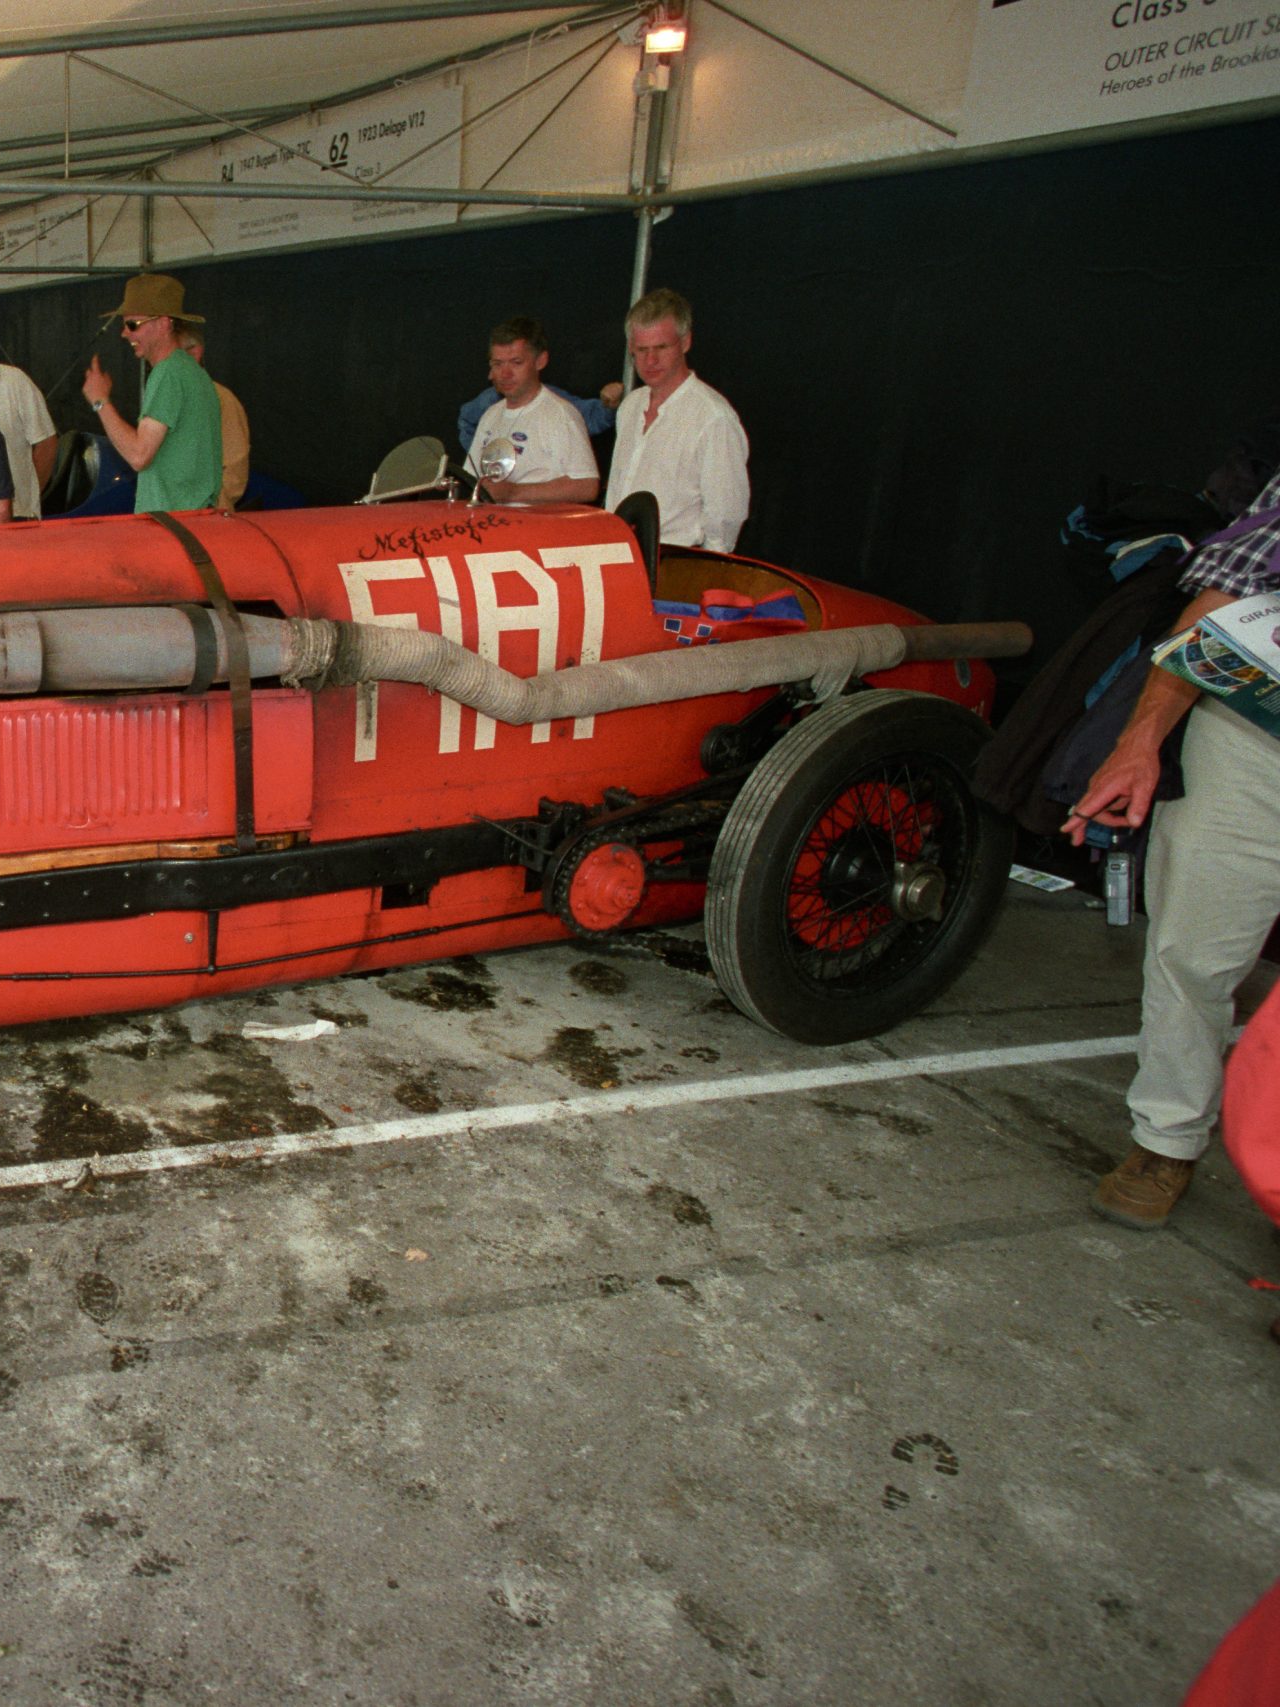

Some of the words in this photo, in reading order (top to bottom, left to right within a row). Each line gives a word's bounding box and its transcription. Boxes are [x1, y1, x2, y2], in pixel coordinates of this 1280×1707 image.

[1112, 0, 1188, 28] Class
[1105, 42, 1168, 71] OUTER
[1175, 19, 1258, 55] CIRCUIT
[1099, 74, 1153, 96] Heroes
[1157, 63, 1176, 84] of
[1180, 62, 1206, 79] the
[358, 125, 378, 144] 1923
[379, 119, 408, 138] Delage
[408, 110, 426, 130] V12
[329, 131, 350, 163] 62
[337, 542, 635, 763] FIAT
